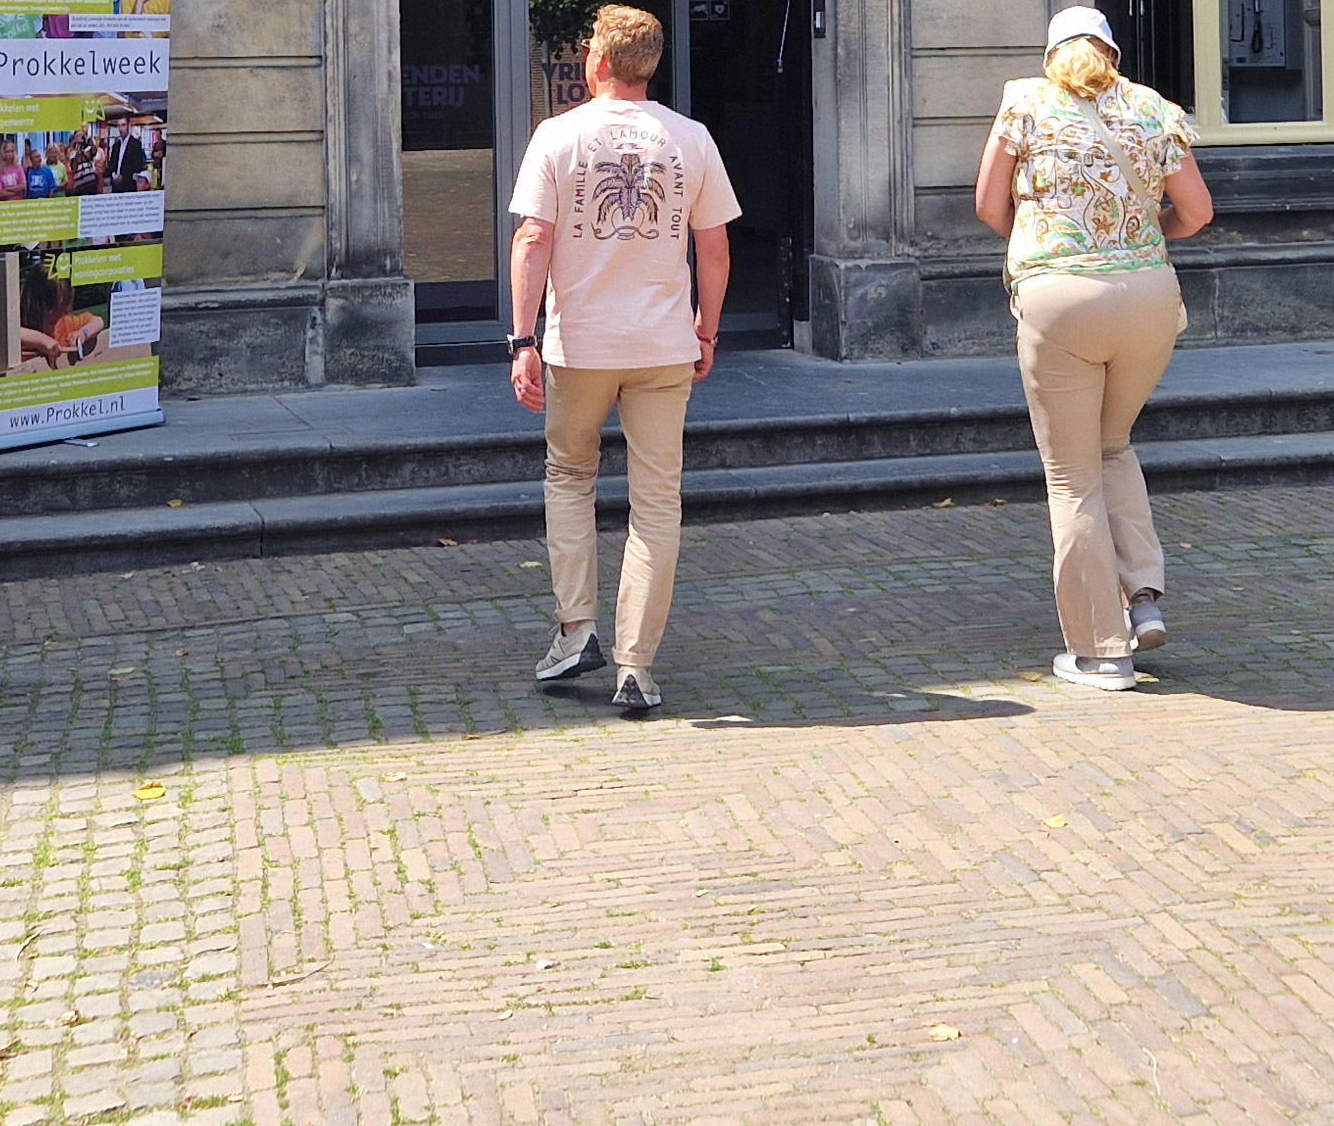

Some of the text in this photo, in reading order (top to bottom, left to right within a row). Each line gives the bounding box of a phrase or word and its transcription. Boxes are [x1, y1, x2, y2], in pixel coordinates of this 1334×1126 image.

[401, 63, 481, 85] ENDEN
[541, 62, 581, 81] VRI
[402, 85, 467, 109] TERIJ
[556, 83, 586, 105] LO
[26, 103, 40, 112] met
[587, 137, 602, 153] ET
[574, 160, 588, 213] FAMILLE
[669, 155, 684, 197] AVANT
[573, 223, 583, 238] LA
[670, 207, 682, 240] TOUT
[74, 253, 122, 265] Prokkelen met
[9, 395, 126, 429] www.Prokkel.nl
